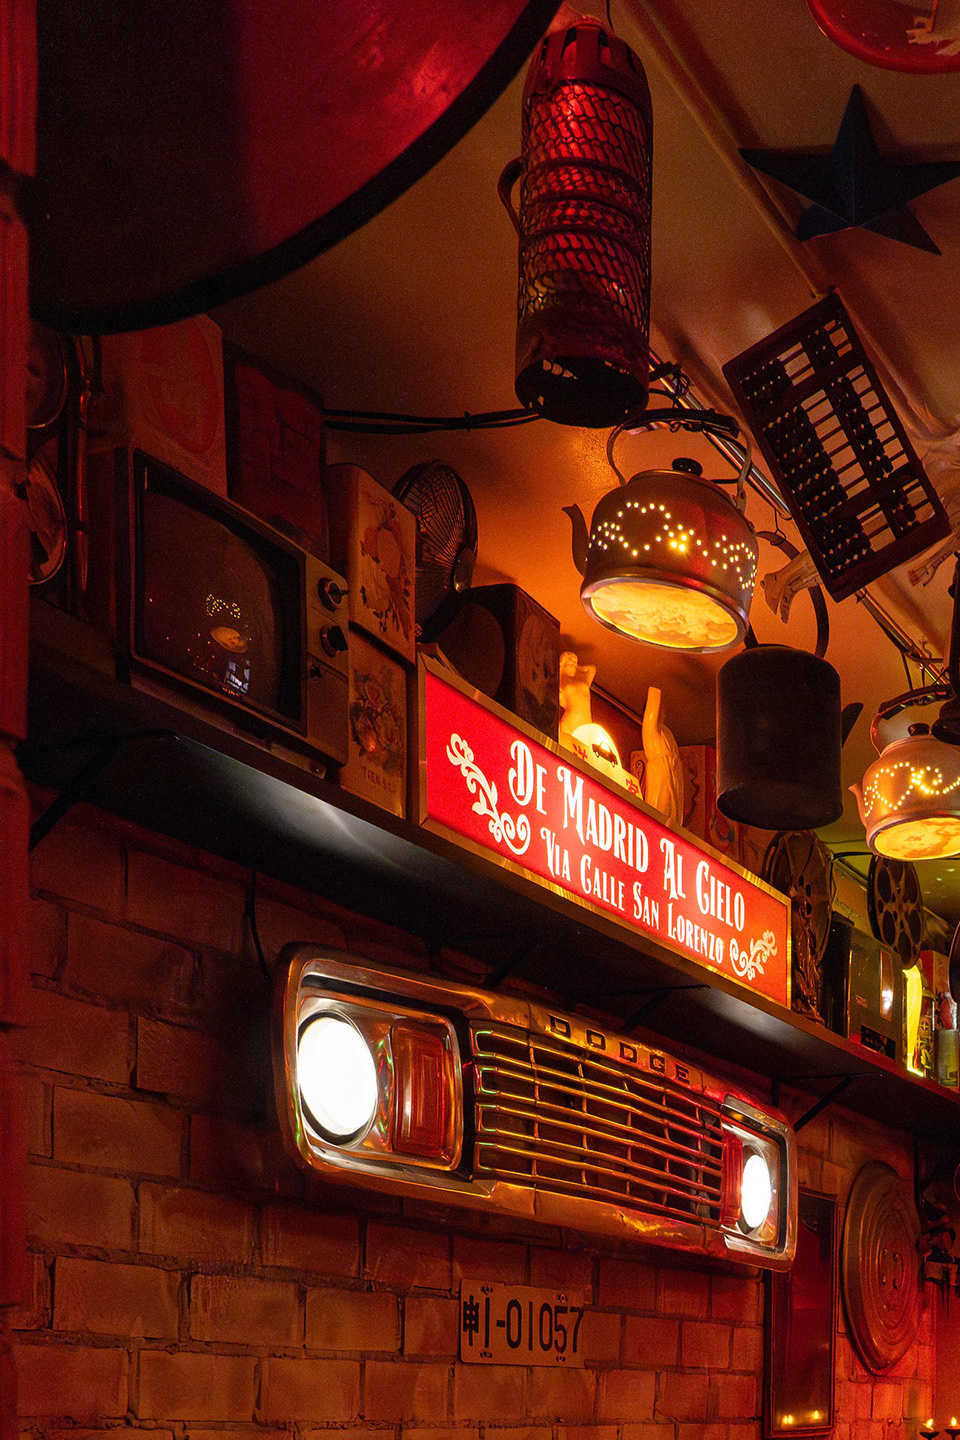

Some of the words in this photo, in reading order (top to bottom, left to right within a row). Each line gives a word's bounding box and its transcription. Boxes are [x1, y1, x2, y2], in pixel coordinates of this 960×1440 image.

[556, 766, 649, 873] MADRID
[696, 860, 746, 932] CIELO
[580, 855, 626, 912] CALLE
[633, 882, 660, 930] SAN
[667, 902, 724, 965] LORENZO
[548, 1014, 691, 1085] DODGE
